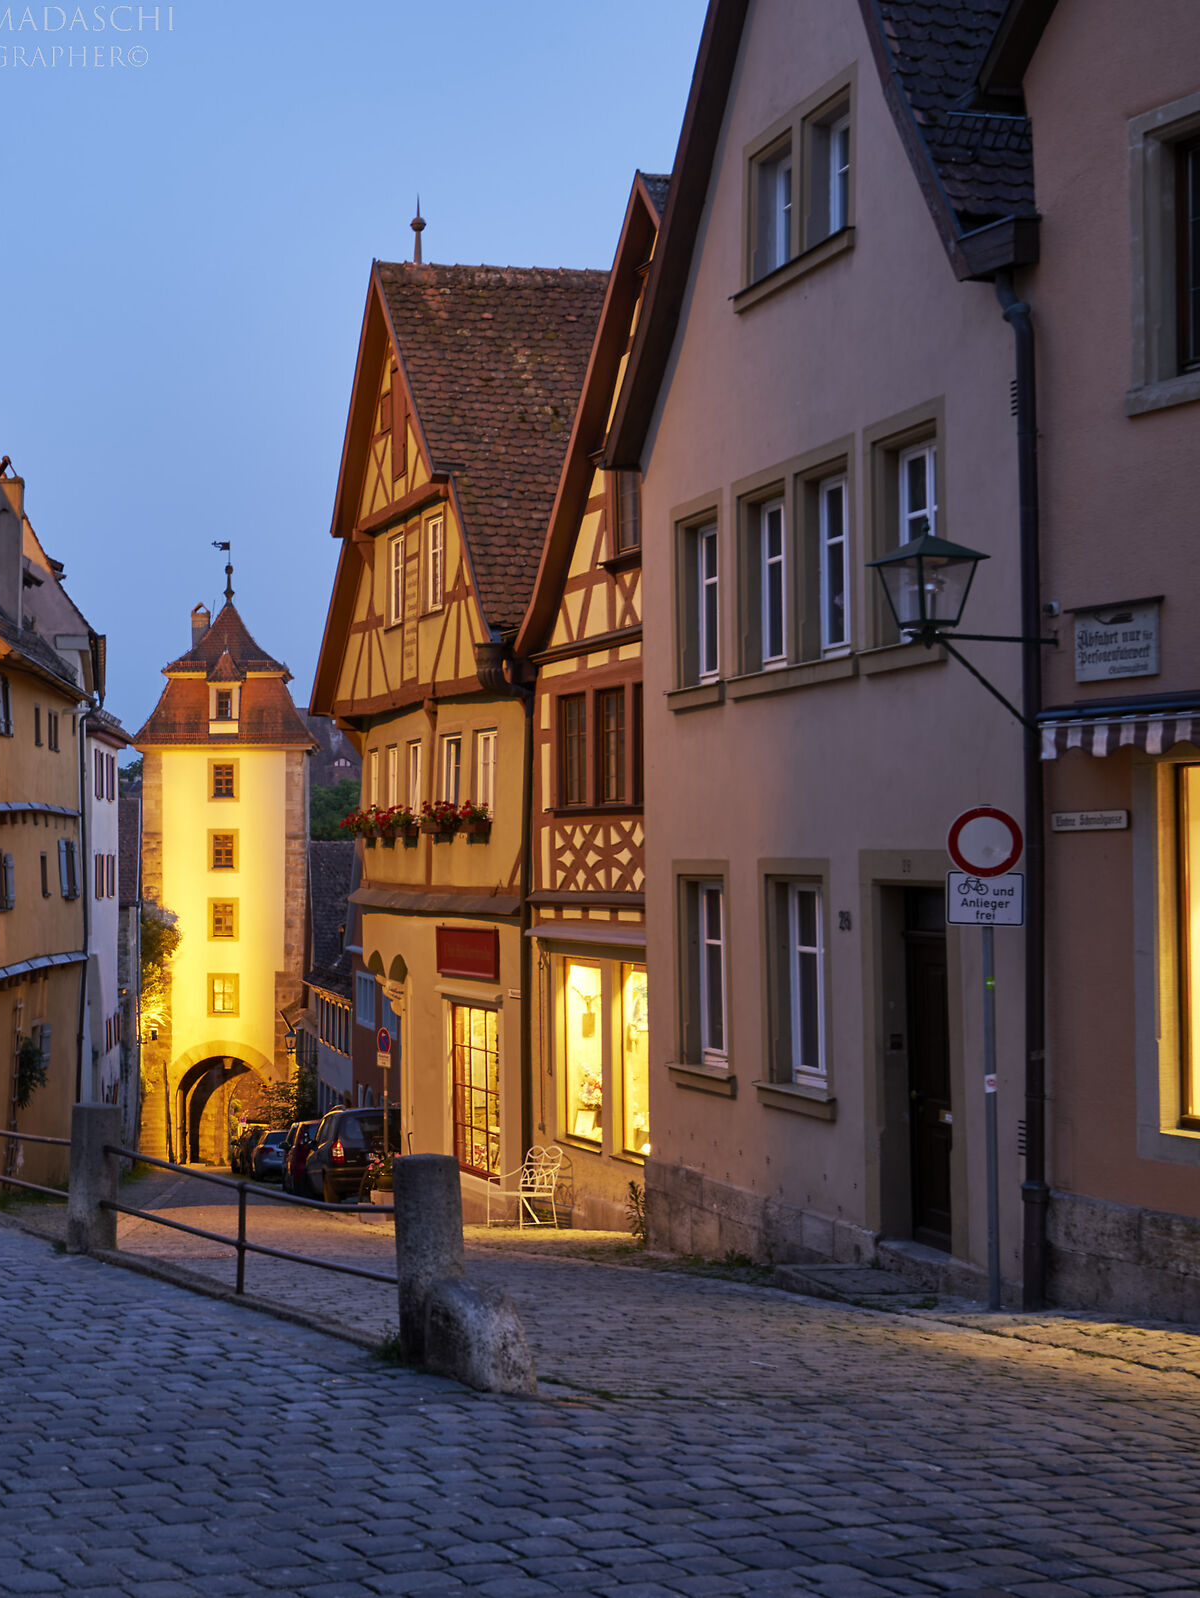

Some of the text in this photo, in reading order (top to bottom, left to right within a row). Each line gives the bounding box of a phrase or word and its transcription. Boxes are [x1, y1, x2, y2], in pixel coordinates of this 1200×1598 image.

[1122, 630, 1141, 643] nur
[993, 887, 1014, 897] und
[961, 898, 1010, 910] Anlieger
[976, 910, 995, 920] frei
